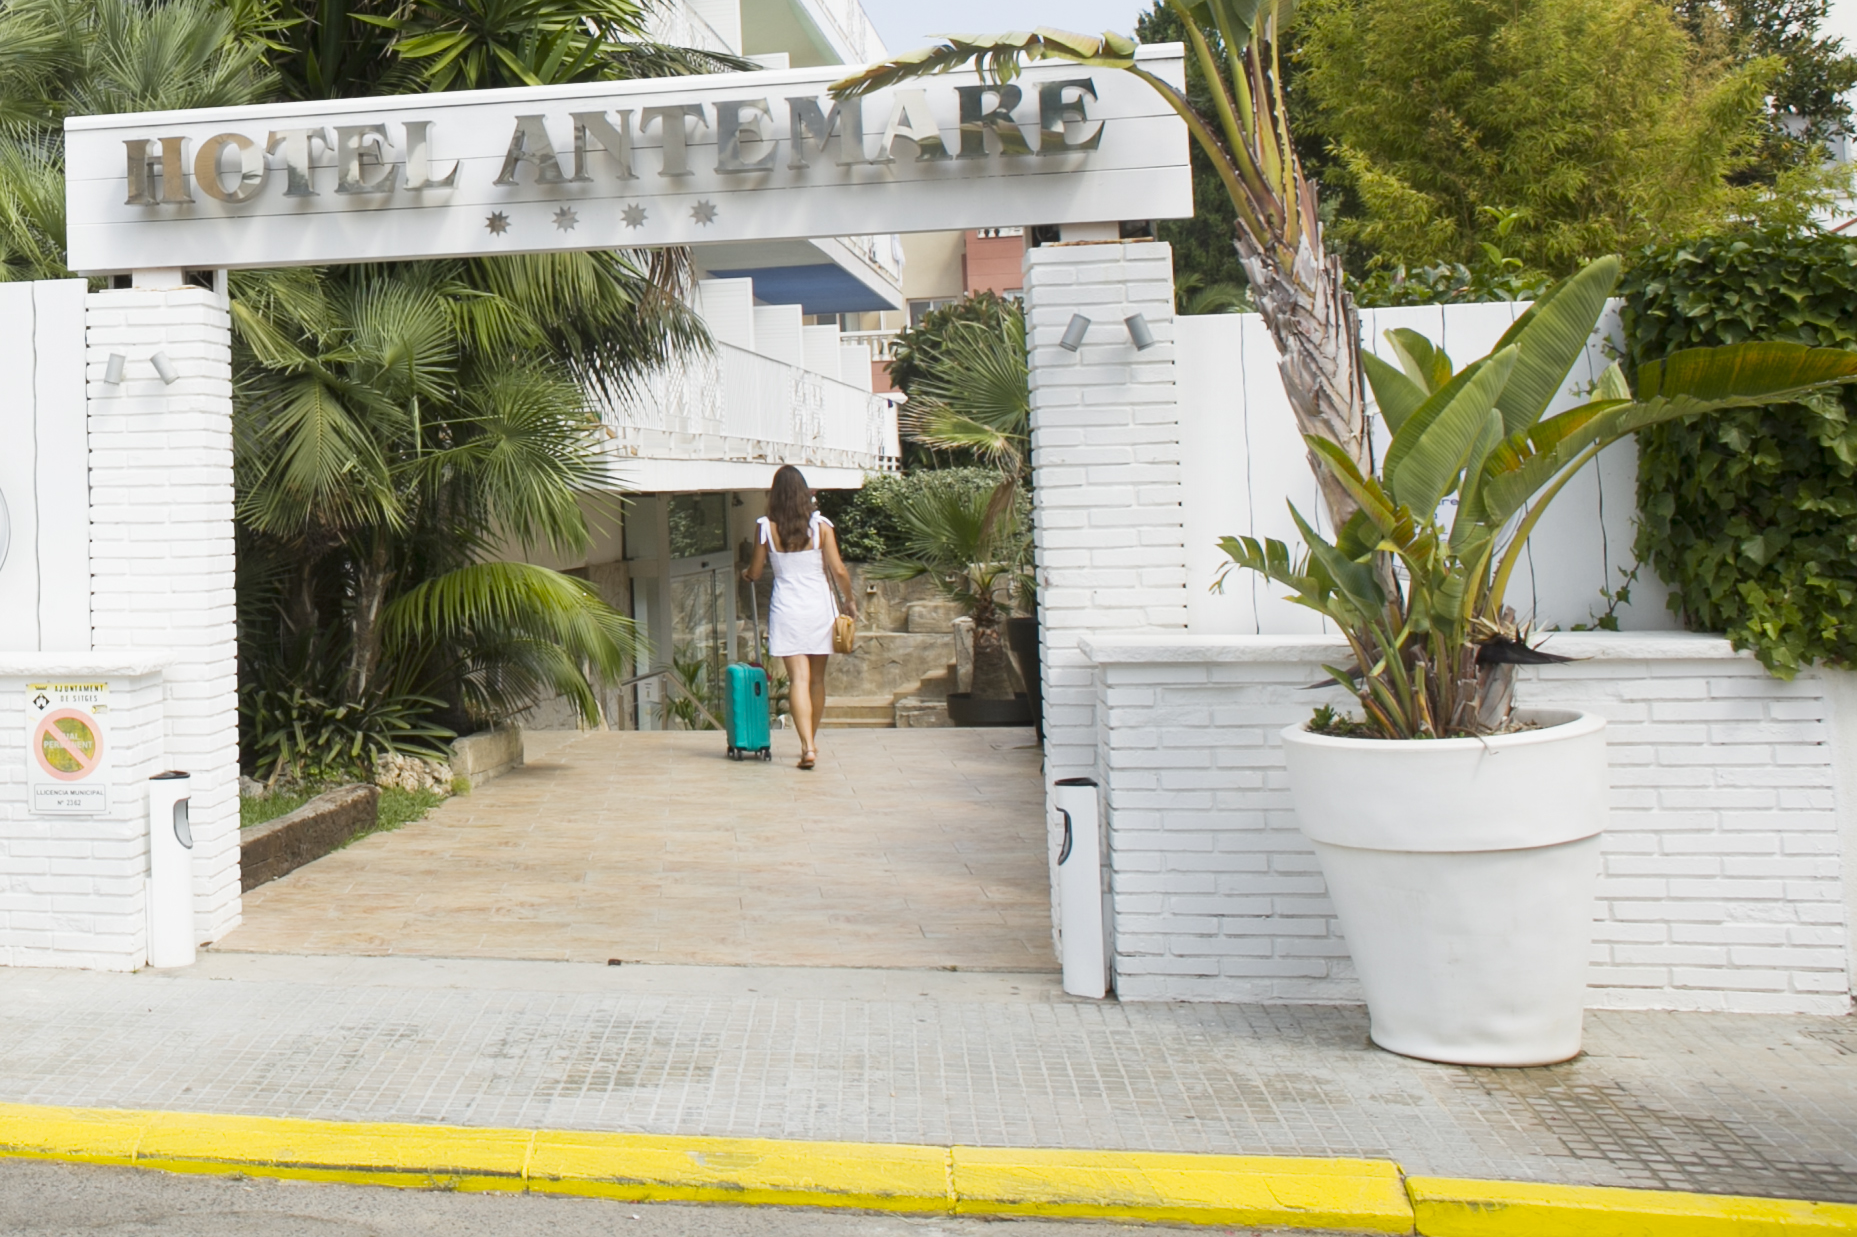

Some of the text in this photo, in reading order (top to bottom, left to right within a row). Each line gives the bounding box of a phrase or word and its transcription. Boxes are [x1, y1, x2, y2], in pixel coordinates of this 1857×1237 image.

[121, 77, 1106, 206] HOTEL ANTEMARE
[54, 684, 104, 692] AJUNTAMENT
[43, 740, 93, 749] PERNENT
